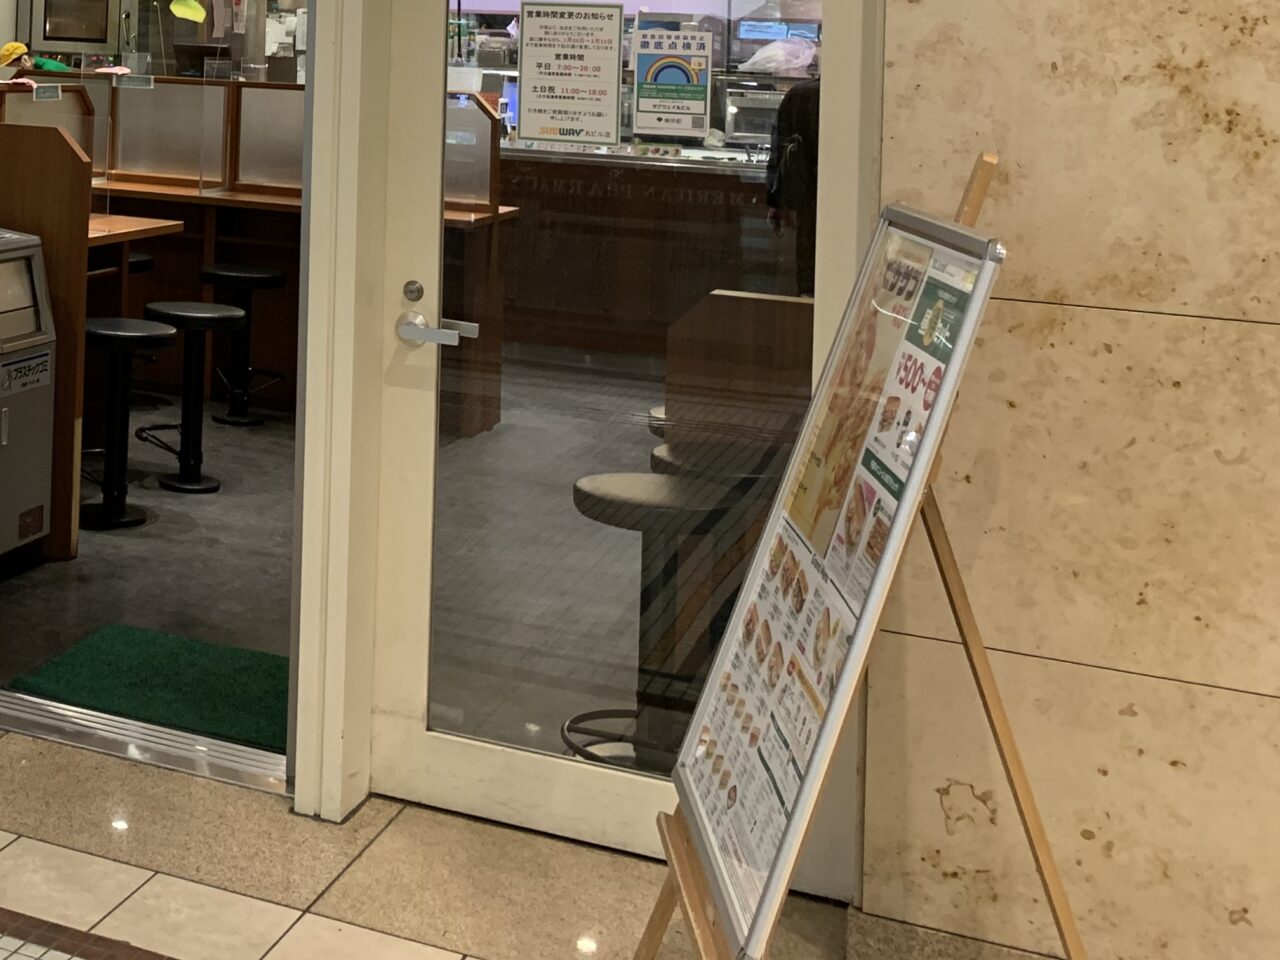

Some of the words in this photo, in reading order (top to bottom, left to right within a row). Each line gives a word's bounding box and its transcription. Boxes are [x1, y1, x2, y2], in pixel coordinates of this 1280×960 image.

[526, 10, 614, 20] 営業時間変更のお知らせ
[536, 62, 551, 70] 平日
[531, 85, 556, 94] 土日祝
[538, 126, 584, 137] SUBWAY
